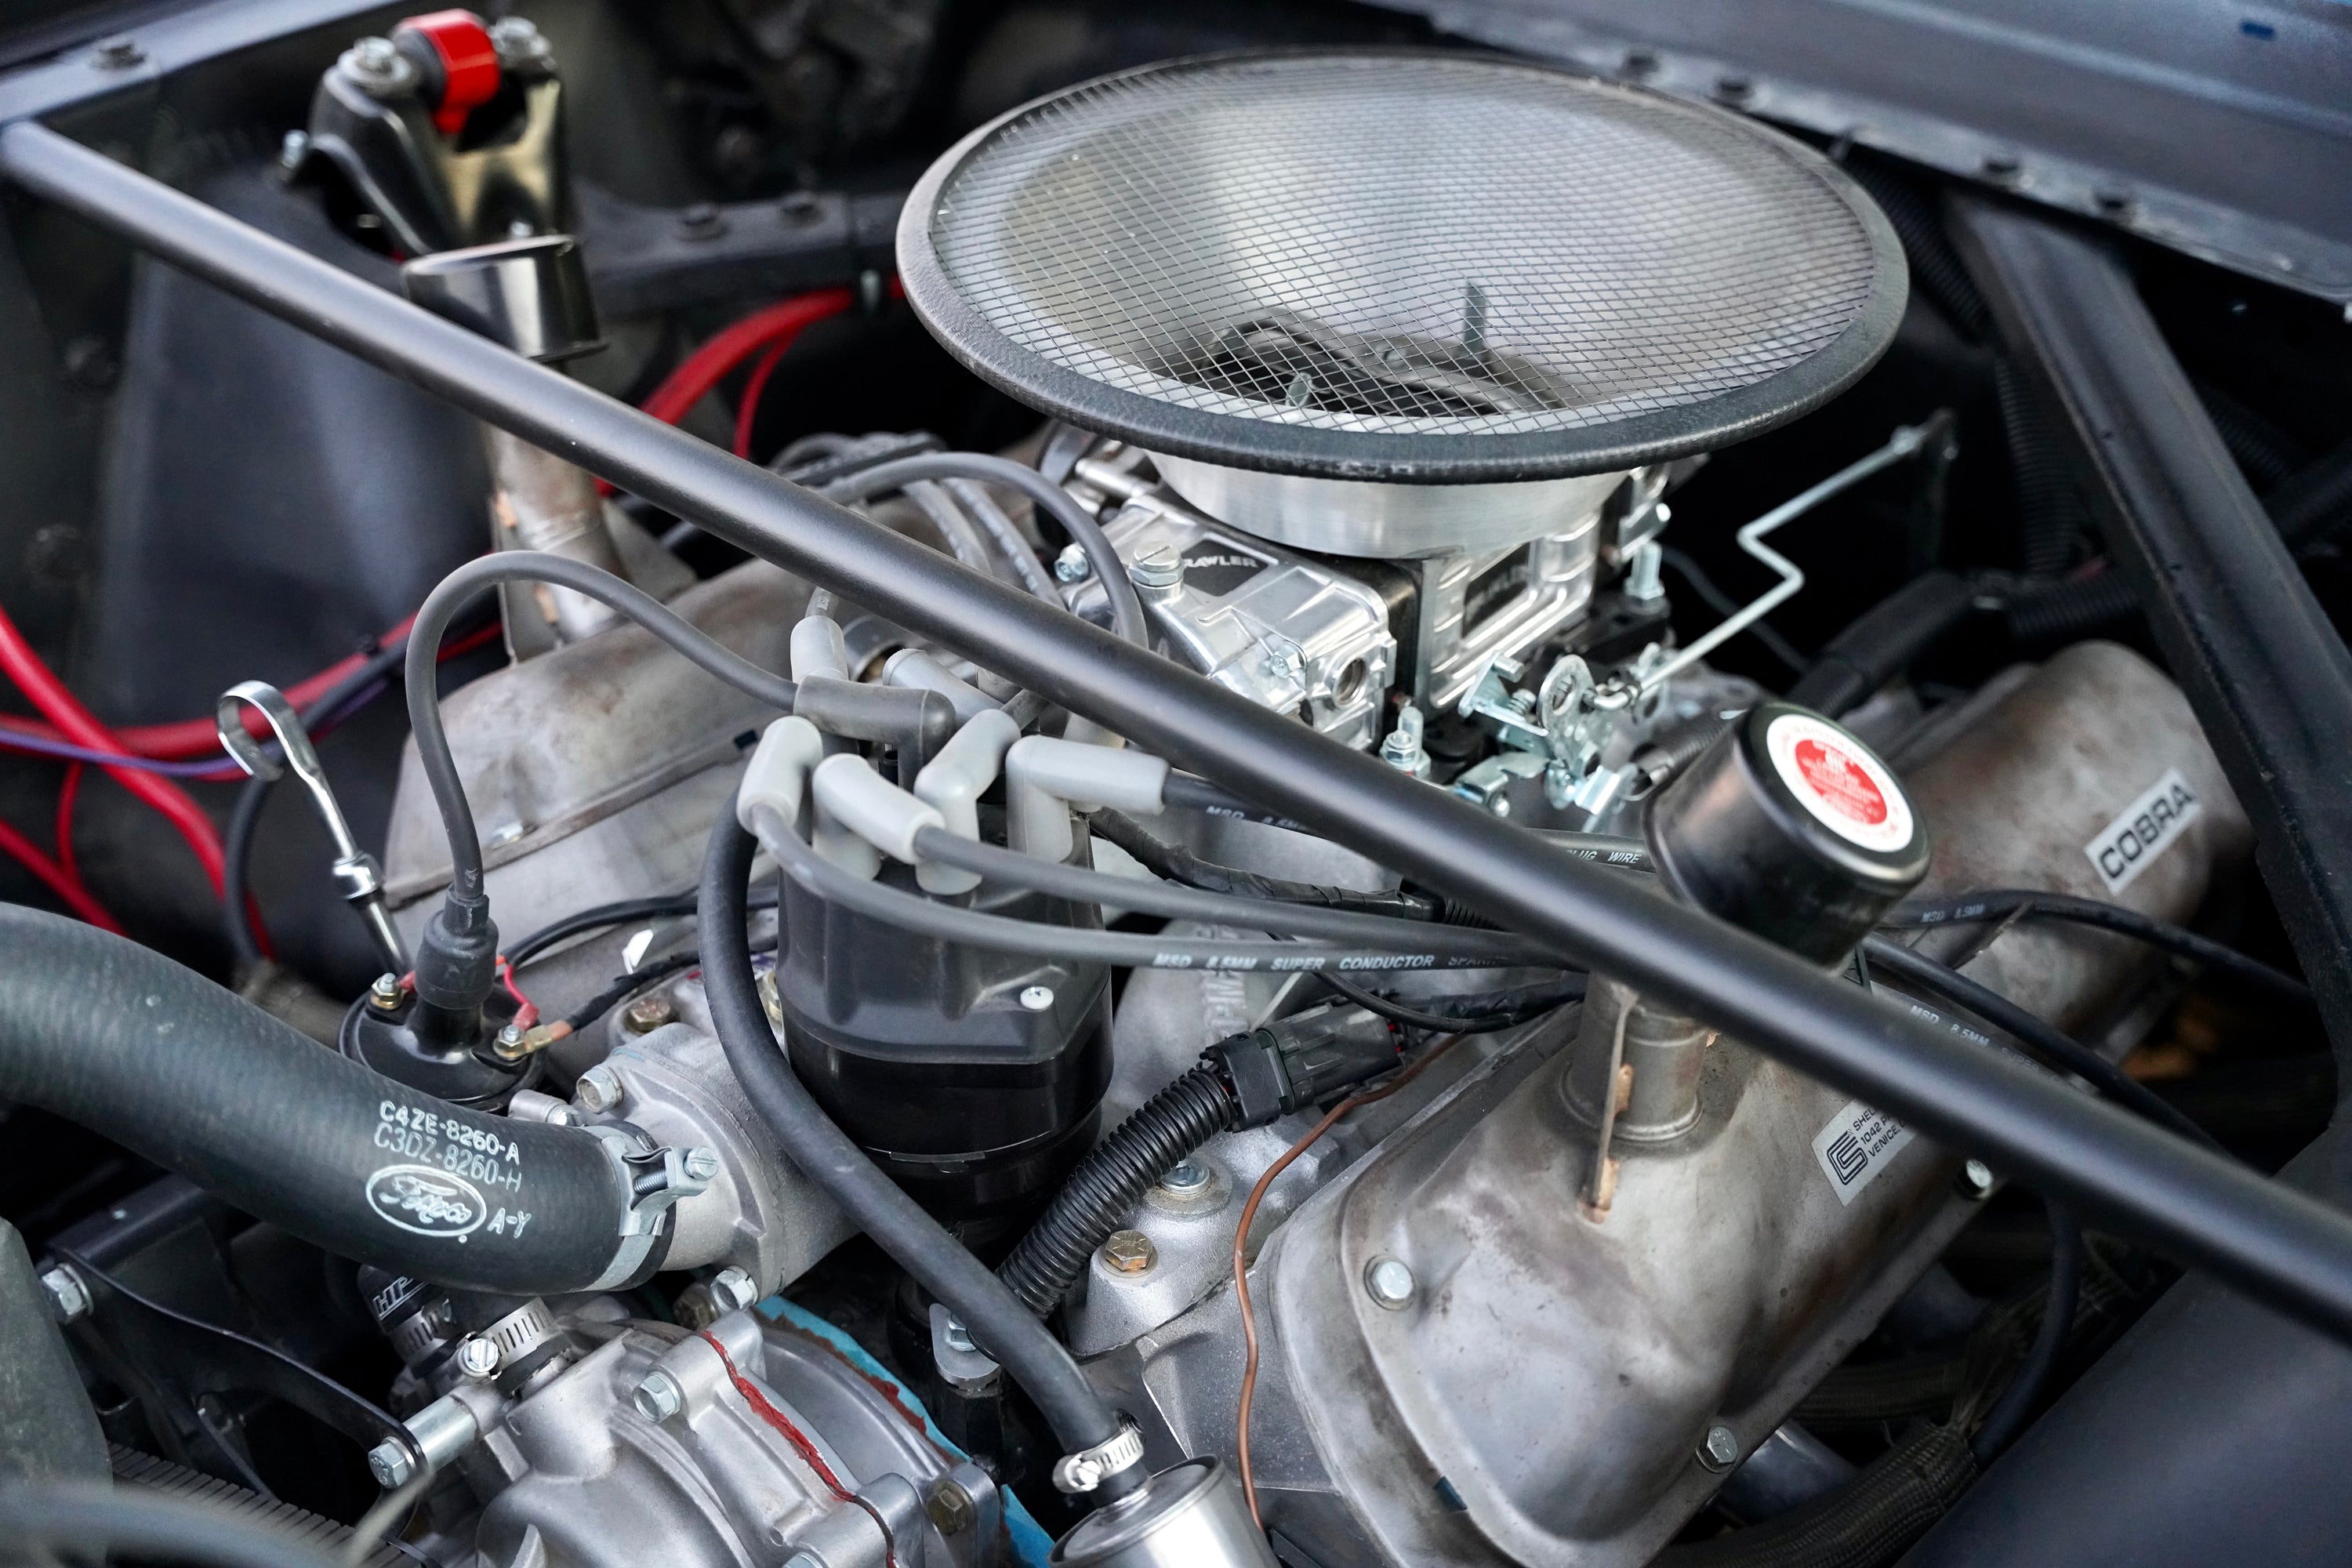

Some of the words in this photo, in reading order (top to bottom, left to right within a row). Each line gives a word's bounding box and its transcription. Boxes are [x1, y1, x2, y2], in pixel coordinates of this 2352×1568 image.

[1181, 555, 1258, 568] RAWLER
[2100, 784, 2194, 879] COBRA
[1607, 851, 1642, 863] WIRE
[1152, 952, 1193, 967] MSD
[1270, 956, 1327, 971] SUPER
[1338, 954, 1436, 970] CONDUCTOR
[1910, 1005, 1940, 1024] MSD
[380, 1101, 520, 1165] C4ZE-8260-A
[1852, 1107, 1878, 1131] SHEL
[1860, 1122, 1882, 1145] 1042
[1868, 1124, 1901, 1156] VENICE,
[374, 1122, 522, 1192] C3DZ-8260-H
[487, 1207, 532, 1239] A-Y
[373, 1276, 414, 1317] HP
